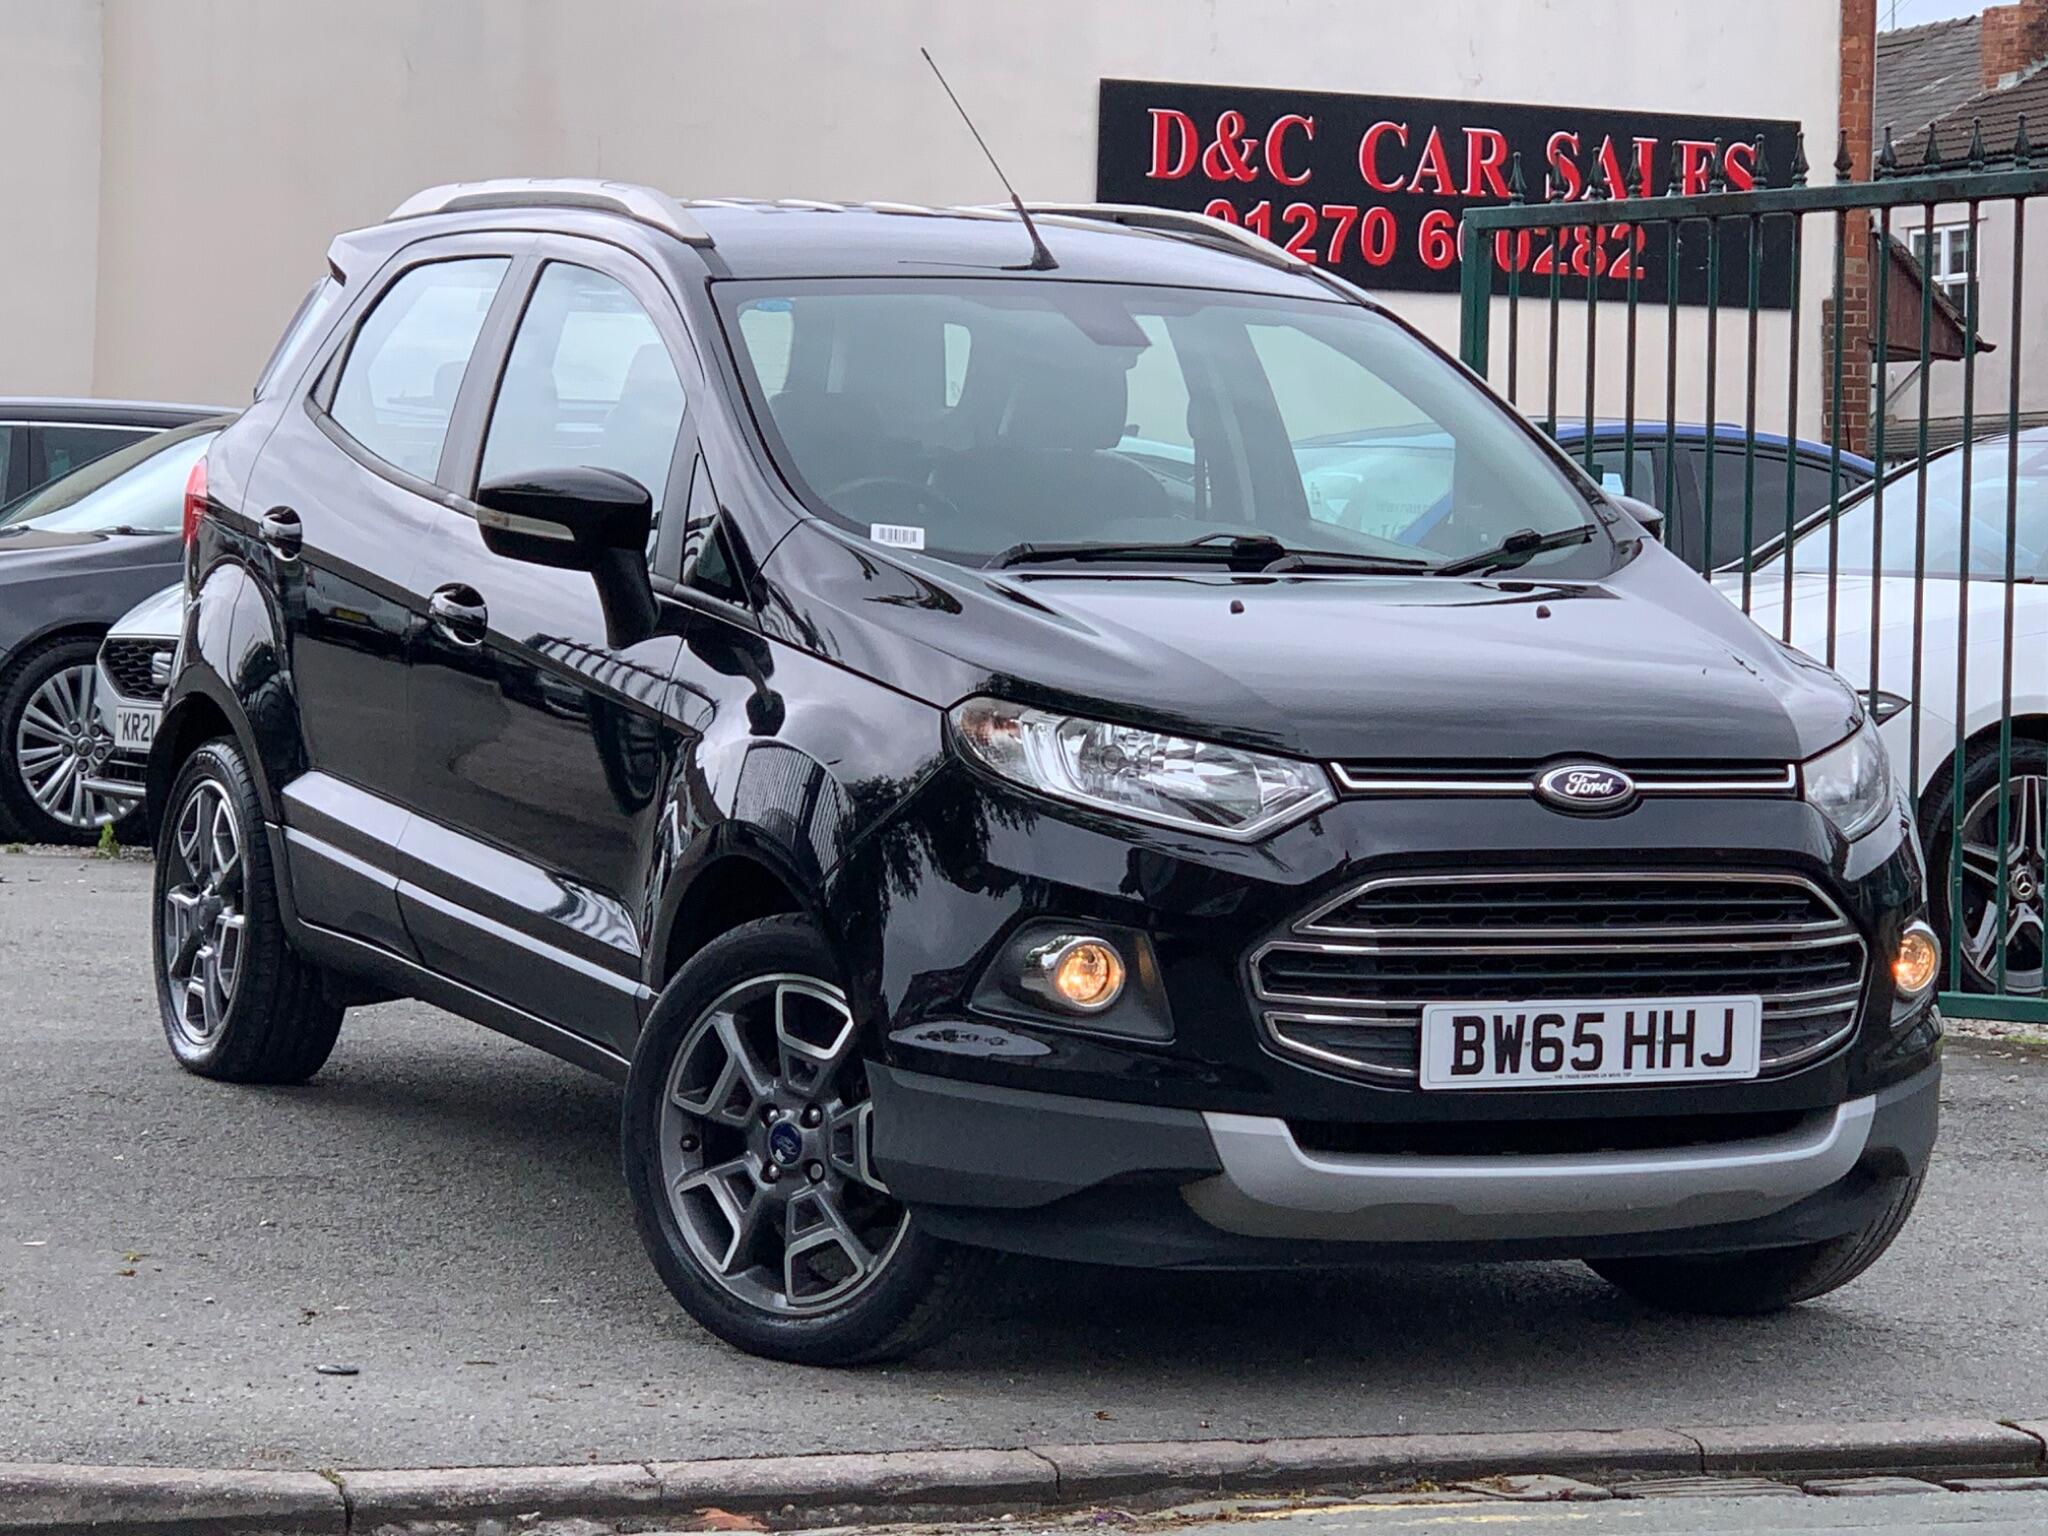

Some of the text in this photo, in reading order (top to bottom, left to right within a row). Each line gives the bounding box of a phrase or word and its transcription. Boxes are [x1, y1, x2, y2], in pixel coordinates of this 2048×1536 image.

[1146, 108, 1315, 186] D&C
[1359, 120, 1512, 198] CAR
[1418, 209, 1646, 280] 60282
[1564, 771, 1614, 795] Ford
[1449, 1008, 1735, 1076] BW65 HHJ
